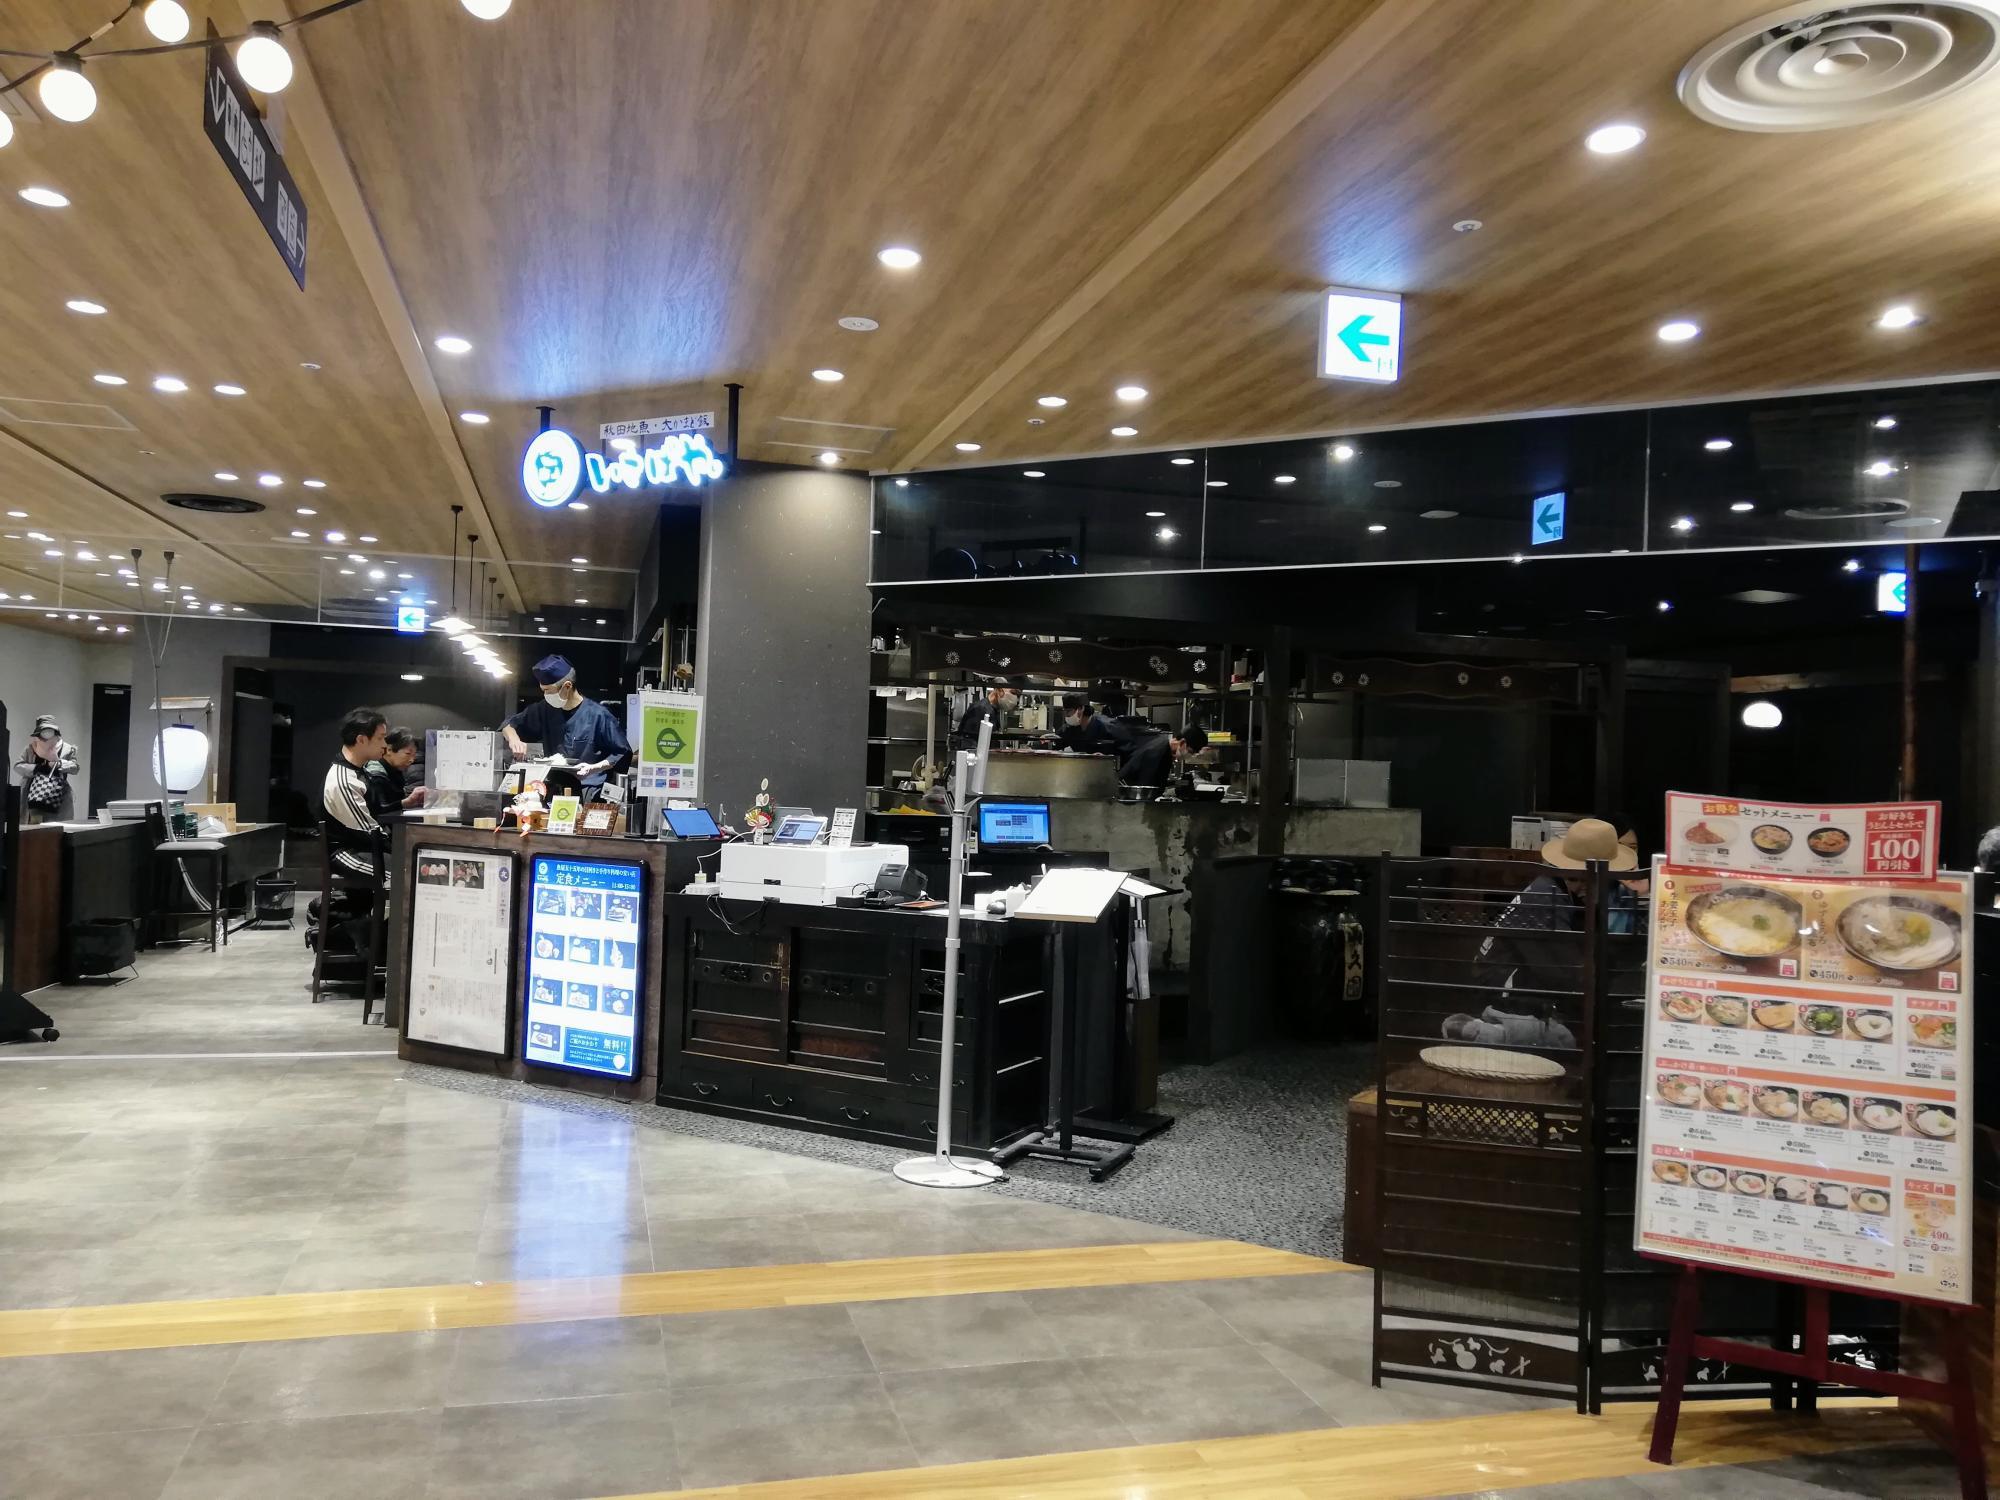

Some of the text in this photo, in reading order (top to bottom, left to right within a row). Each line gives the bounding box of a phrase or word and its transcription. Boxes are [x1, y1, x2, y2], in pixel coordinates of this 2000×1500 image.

[1703, 803, 1815, 820] お得な セットメニュー
[1869, 838, 1920, 860] 100
[1876, 859, 1911, 871] 円引き
[555, 873, 606, 887] 定食メニュー
